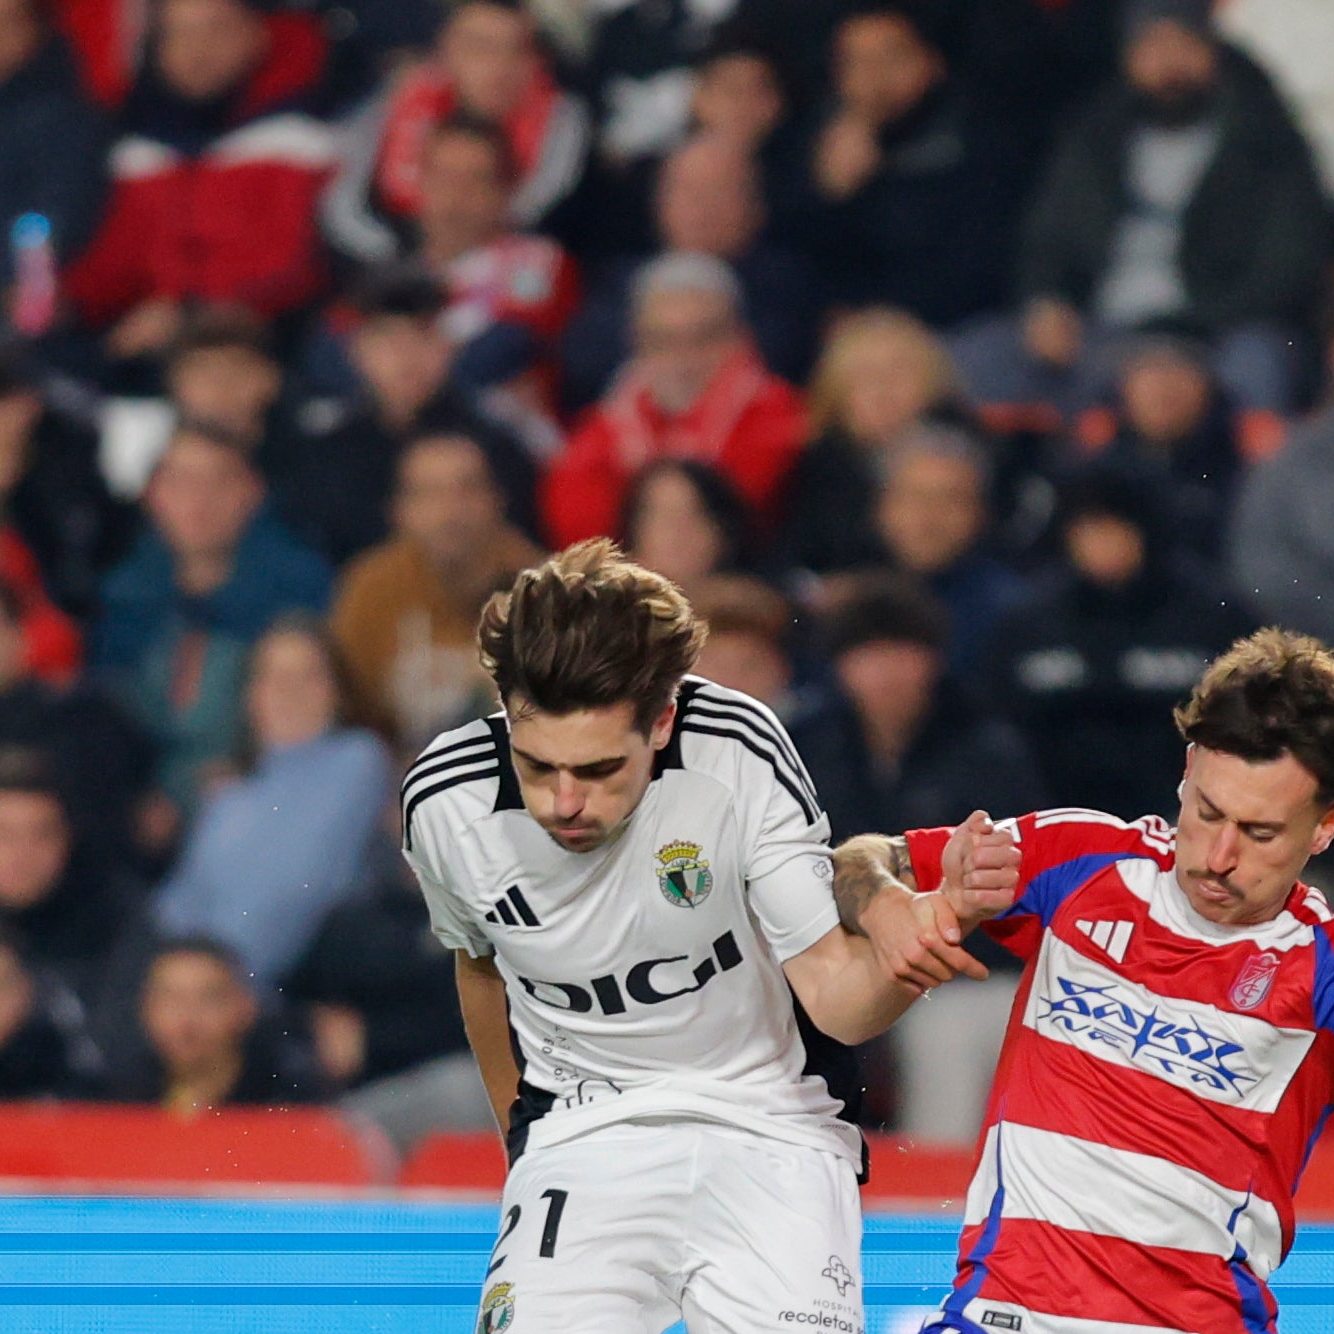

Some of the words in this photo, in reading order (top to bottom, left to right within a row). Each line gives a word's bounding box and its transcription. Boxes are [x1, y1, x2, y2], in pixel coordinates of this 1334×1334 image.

[518, 929, 743, 1015] DIGI
[485, 1188, 569, 1283] 21
[778, 1310, 853, 1333] recoletas
